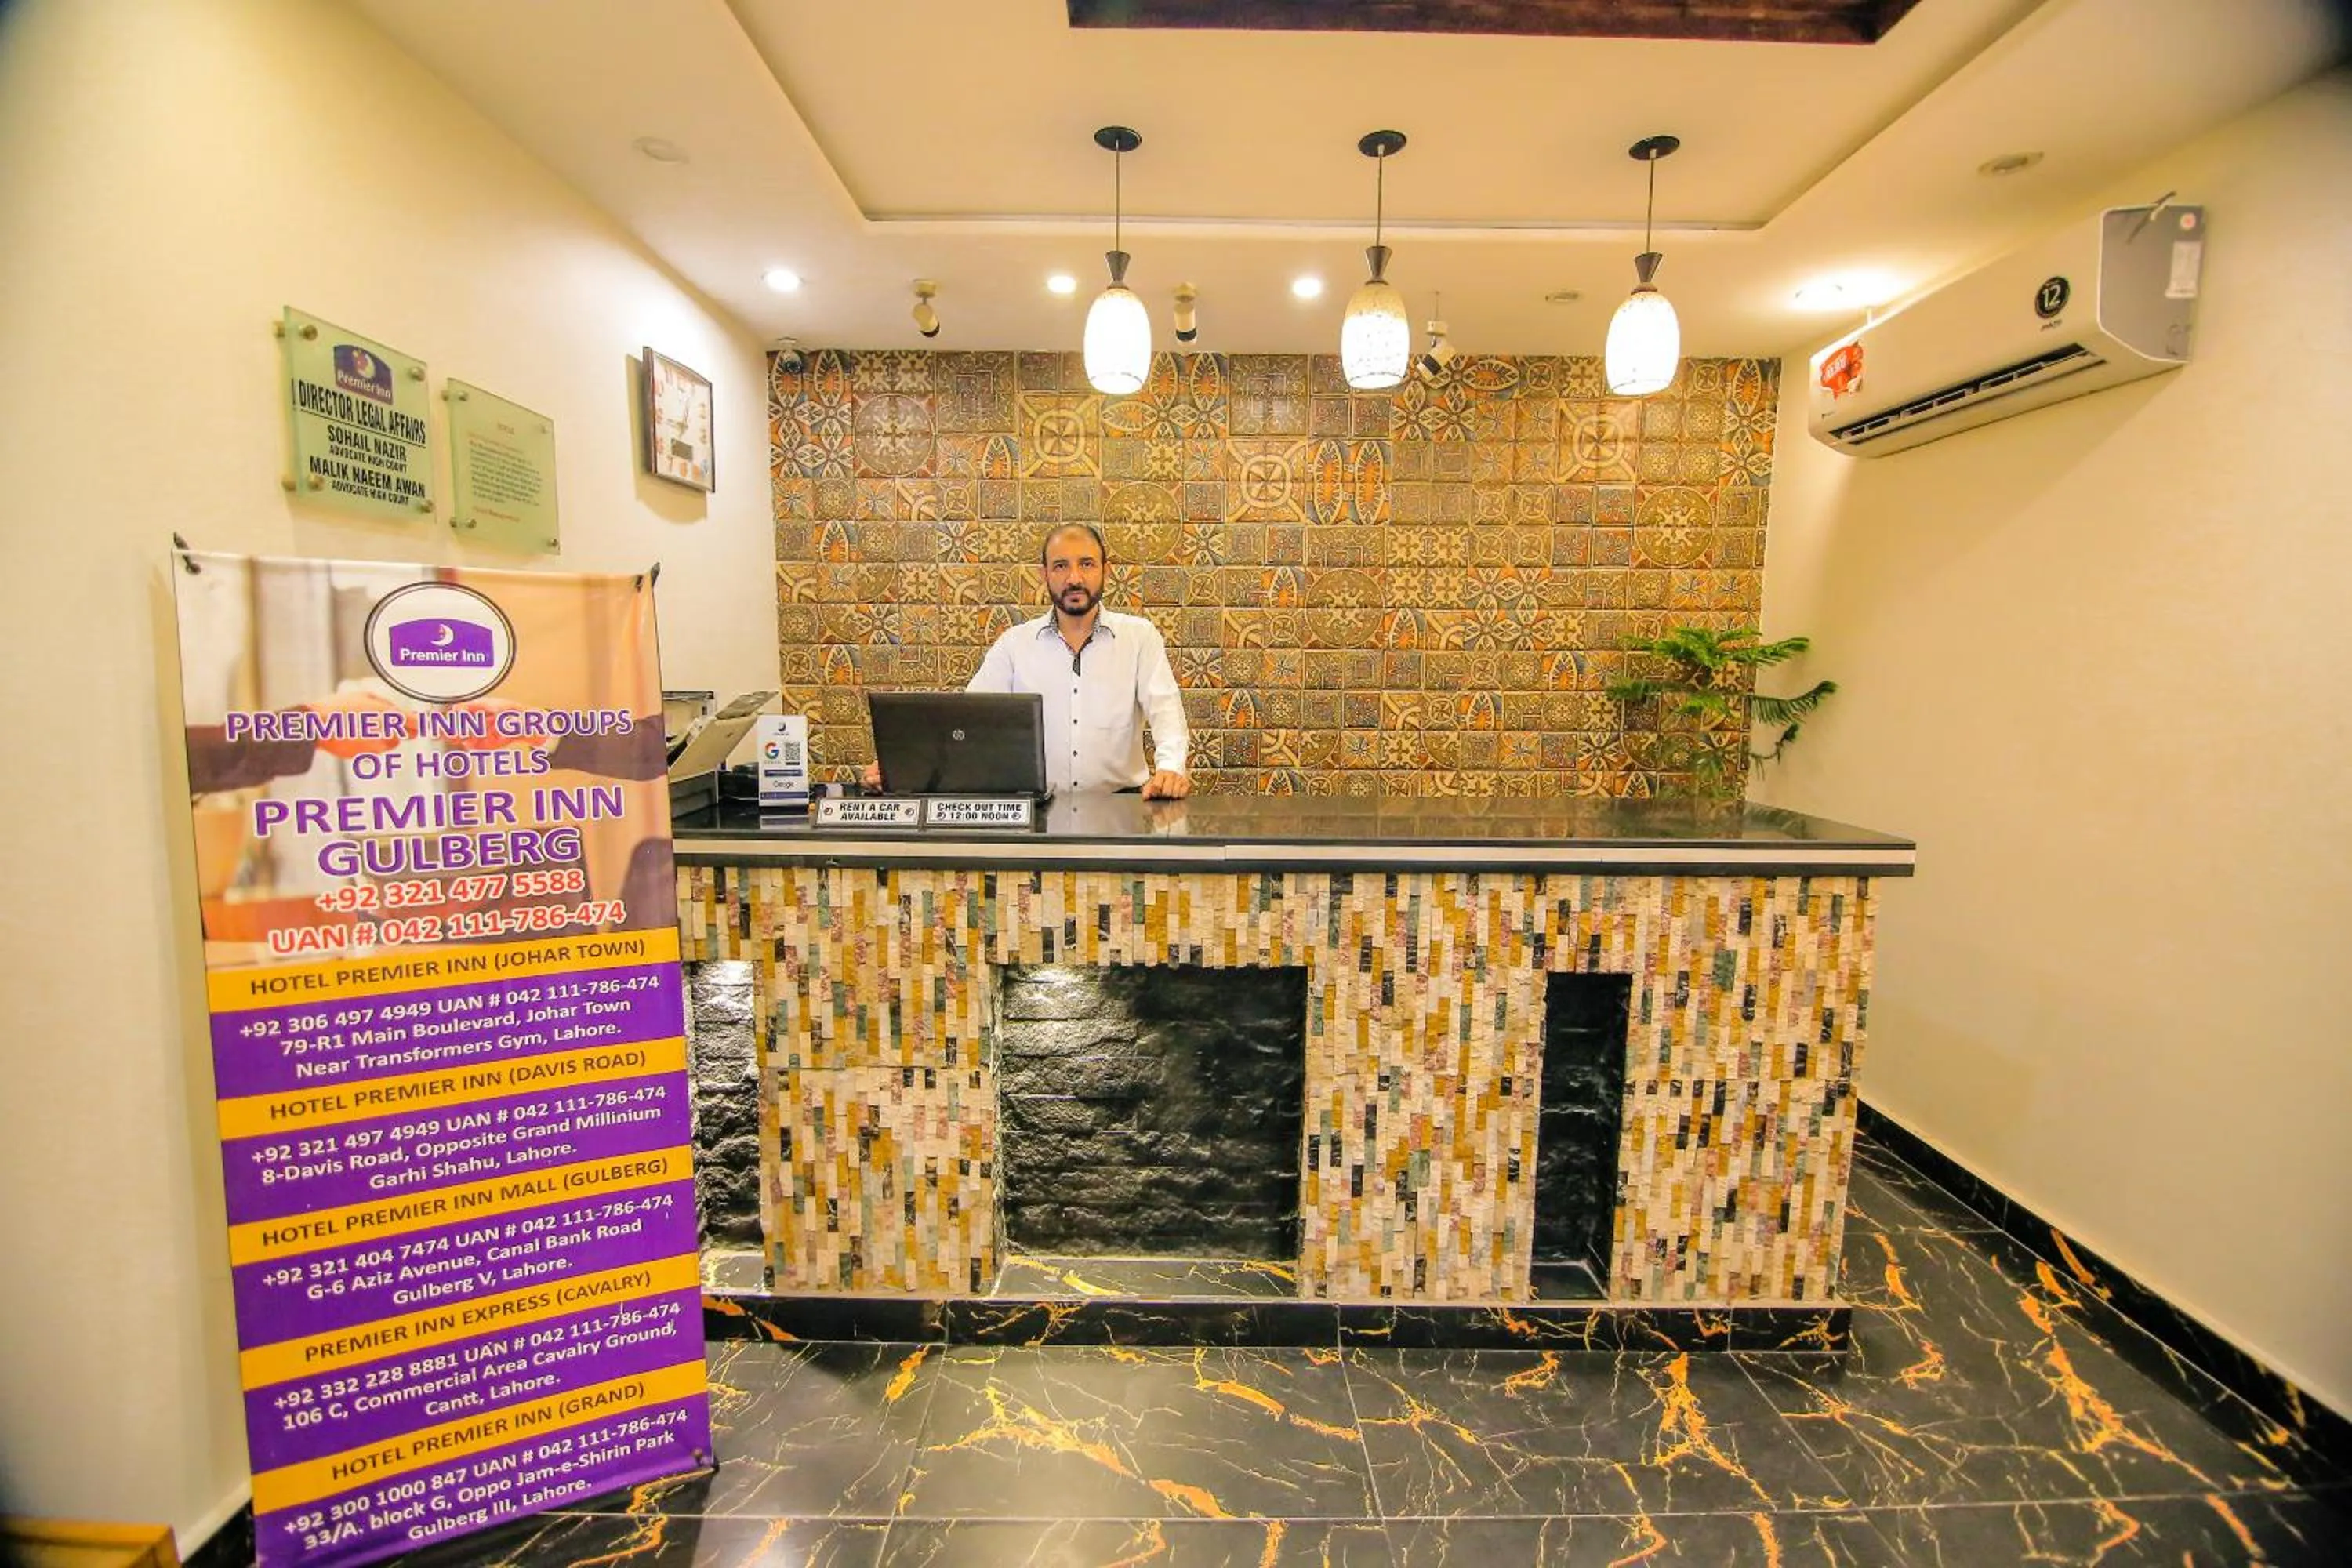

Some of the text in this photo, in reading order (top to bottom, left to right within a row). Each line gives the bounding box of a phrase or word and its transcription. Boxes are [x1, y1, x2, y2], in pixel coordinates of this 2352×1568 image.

[2042, 285, 2061, 309] 12
[337, 371, 391, 399] Premier Inn
[299, 379, 426, 444] DIRECTOR LEGAL AFFAIRS
[327, 425, 407, 462] SOHAIL NAZIR
[330, 445, 407, 474] ADVOCATE HIGH COURT
[310, 456, 425, 498] MALIK NAEEM AWAN
[332, 480, 408, 504] ADVOCATE HIGH COURT
[400, 648, 485, 662] Premier Inn
[227, 709, 633, 741] PREMIER INN GROUPS
[352, 749, 550, 780] OF HOTELS
[253, 786, 625, 838] PREMIER INN
[840, 803, 901, 811] RENT A CAR
[840, 812, 896, 821] AVAILABLE
[937, 803, 1022, 811] CHECK OUT TIME
[950, 811, 1010, 820] 12:00 NOON
[318, 829, 580, 877] GULBERG
[317, 870, 584, 913] +92 321 477 5588
[270, 901, 625, 954] UAN # 042 111-786-474
[250, 940, 645, 995] HOTEL PREMIER INN (JOHAR TOWN)
[239, 975, 659, 1039] +92 306 497 4949 UAN # 042 111-786-474
[281, 997, 631, 1056] 79-R1 Main Boulevard, Johar Town
[296, 1022, 622, 1080] Near Transformers Gym, Lahore.
[270, 1050, 646, 1120] HOTEL PREMIER INN (DAVIS ROAD)
[252, 1084, 666, 1164] +92 321 497 4949 UAN # 042 111-786-474
[262, 1105, 661, 1185] 8-Davis Road, Opposite Grand Millinium
[369, 1143, 577, 1190] Garhi Shahu, Lahore.
[262, 1160, 669, 1246] HOTEL PREMIER INN MALL (GULBERG)
[263, 1194, 673, 1287] +92 321 404 7474 UAN # 042 111-786-474
[307, 1219, 642, 1302] G-6 Aziz Avenue, Canal Bank Road
[393, 1256, 573, 1305] Gulberg V, Lahore.
[305, 1270, 652, 1362] PREMIER INN EXPRESS (CAVALRY)
[274, 1302, 681, 1410] +92 332 228 8881 UAN # 042 111-786-474
[282, 1319, 677, 1432] 106 C, Commercial Area Cavalry Ground,
[425, 1374, 561, 1416] Cantt, Lahore.
[332, 1383, 645, 1481] HOTEL PREMIER INN (GRAND)
[285, 1408, 688, 1537] +92 300 1000 847 UAN # 042 111-786-474
[370, 1503, 426, 1529] block
[431, 1494, 453, 1513] G,
[459, 1479, 512, 1504] Oppo
[516, 1444, 632, 1490] Jam-e-Shirin
[637, 1432, 675, 1453] Park
[408, 1479, 593, 1541] Gulberg III, Lahore.
